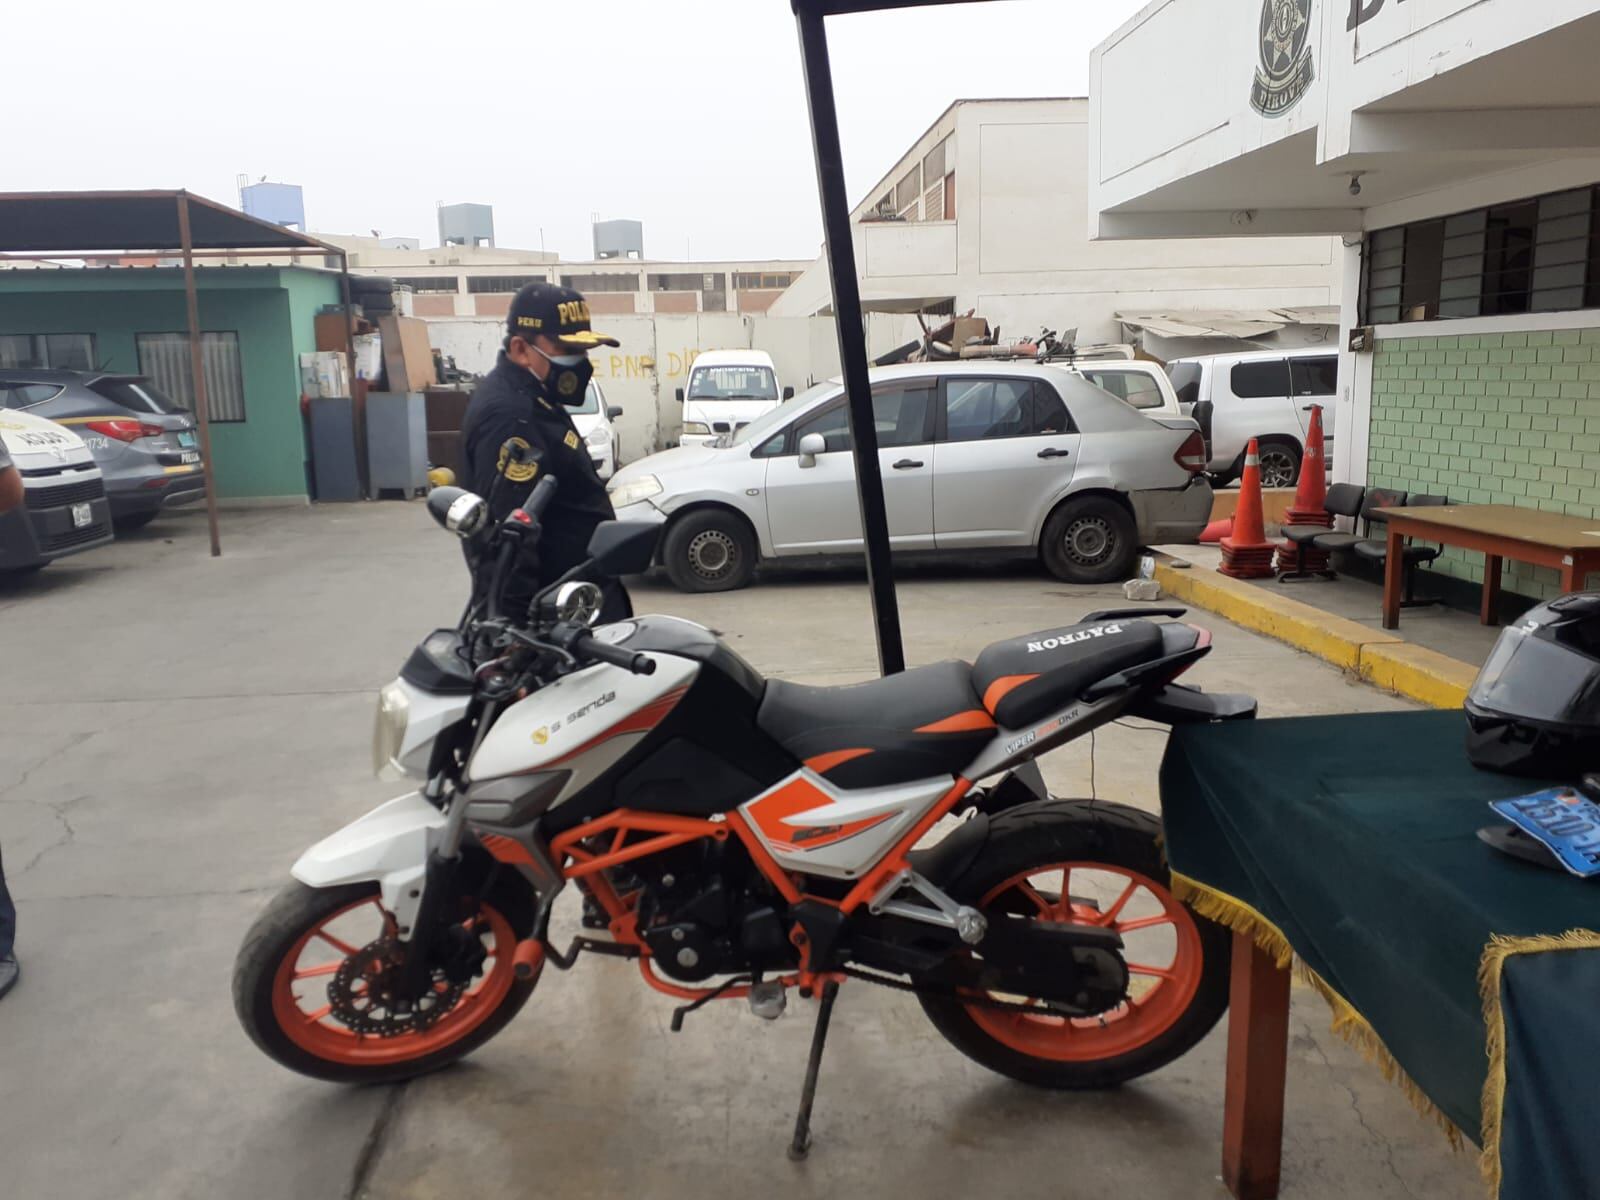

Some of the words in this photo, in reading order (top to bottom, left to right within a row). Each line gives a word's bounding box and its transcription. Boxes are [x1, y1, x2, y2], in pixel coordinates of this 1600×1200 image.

[517, 316, 542, 328] PERU
[1027, 624, 1123, 653] PATRON
[1005, 731, 1036, 755] VIPER
